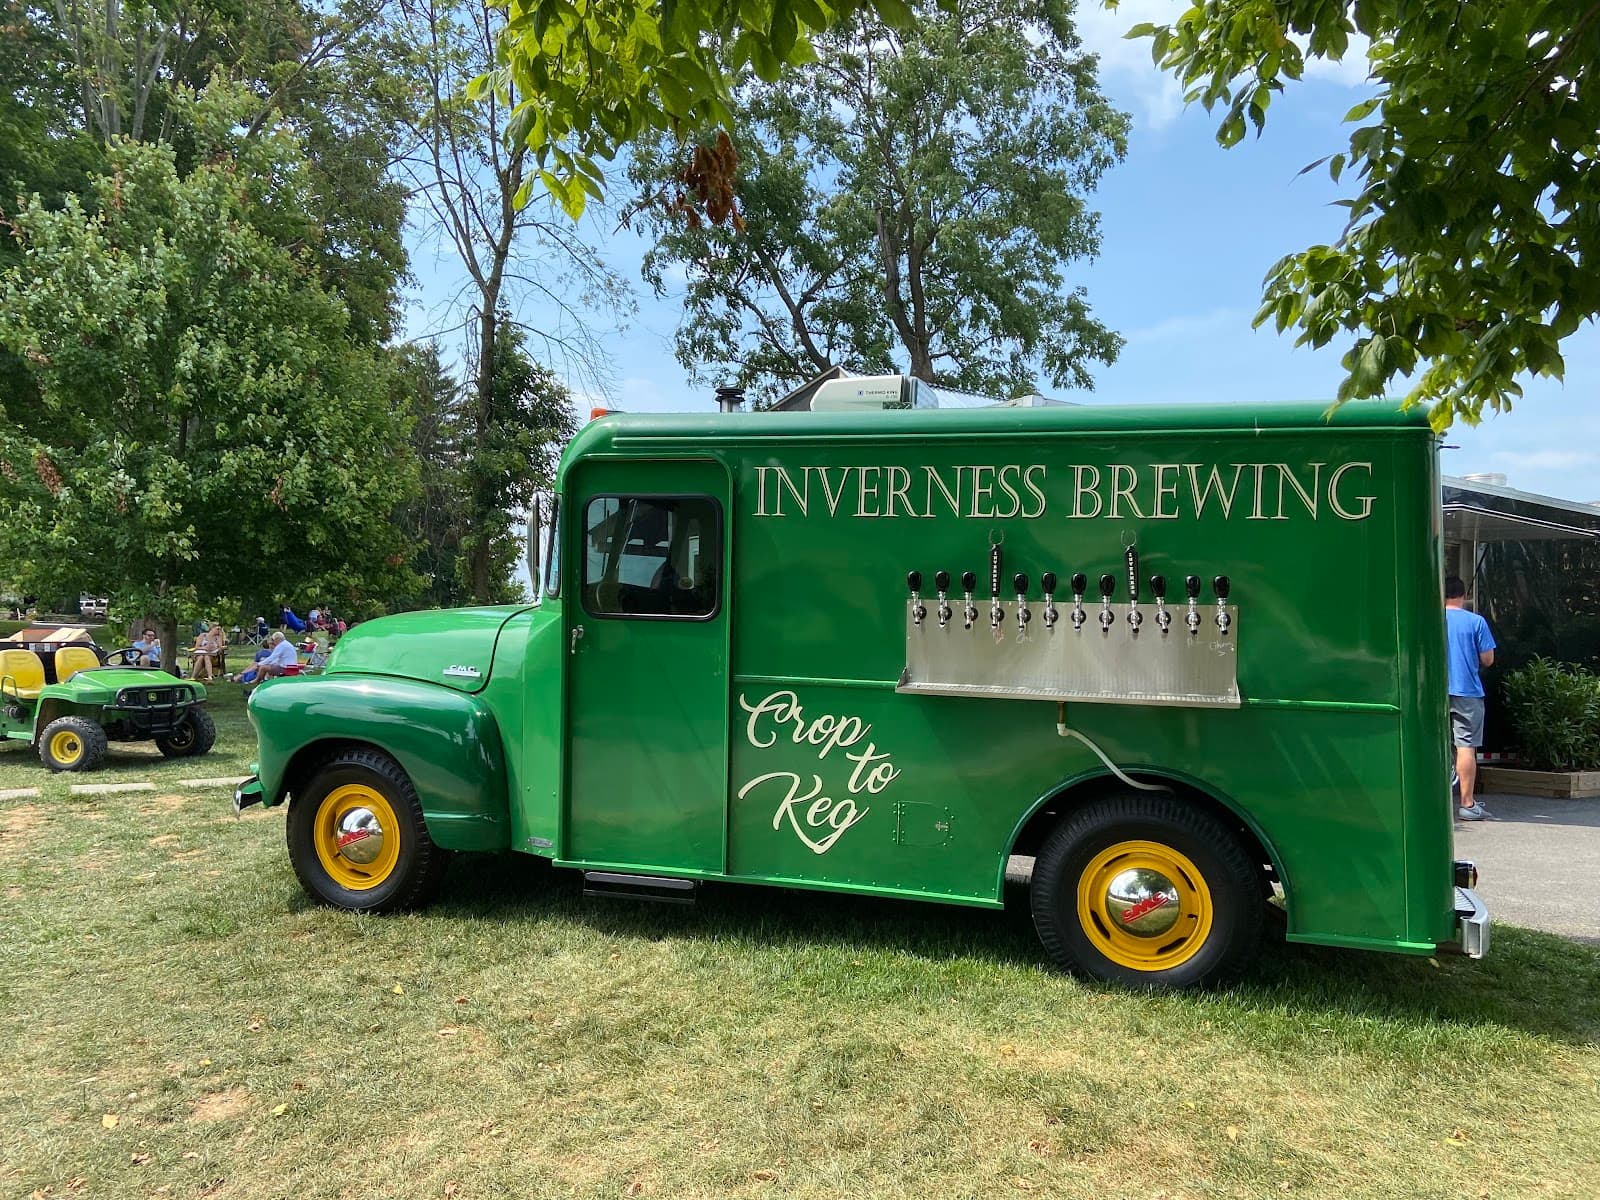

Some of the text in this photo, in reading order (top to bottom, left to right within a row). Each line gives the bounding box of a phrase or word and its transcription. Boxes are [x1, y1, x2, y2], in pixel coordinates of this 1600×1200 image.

[752, 461, 1377, 521] INVERNESS BREWING
[739, 690, 872, 760] Crop
[845, 742, 901, 794] to
[737, 771, 870, 855] Keg
[1121, 891, 1168, 922] GMC
